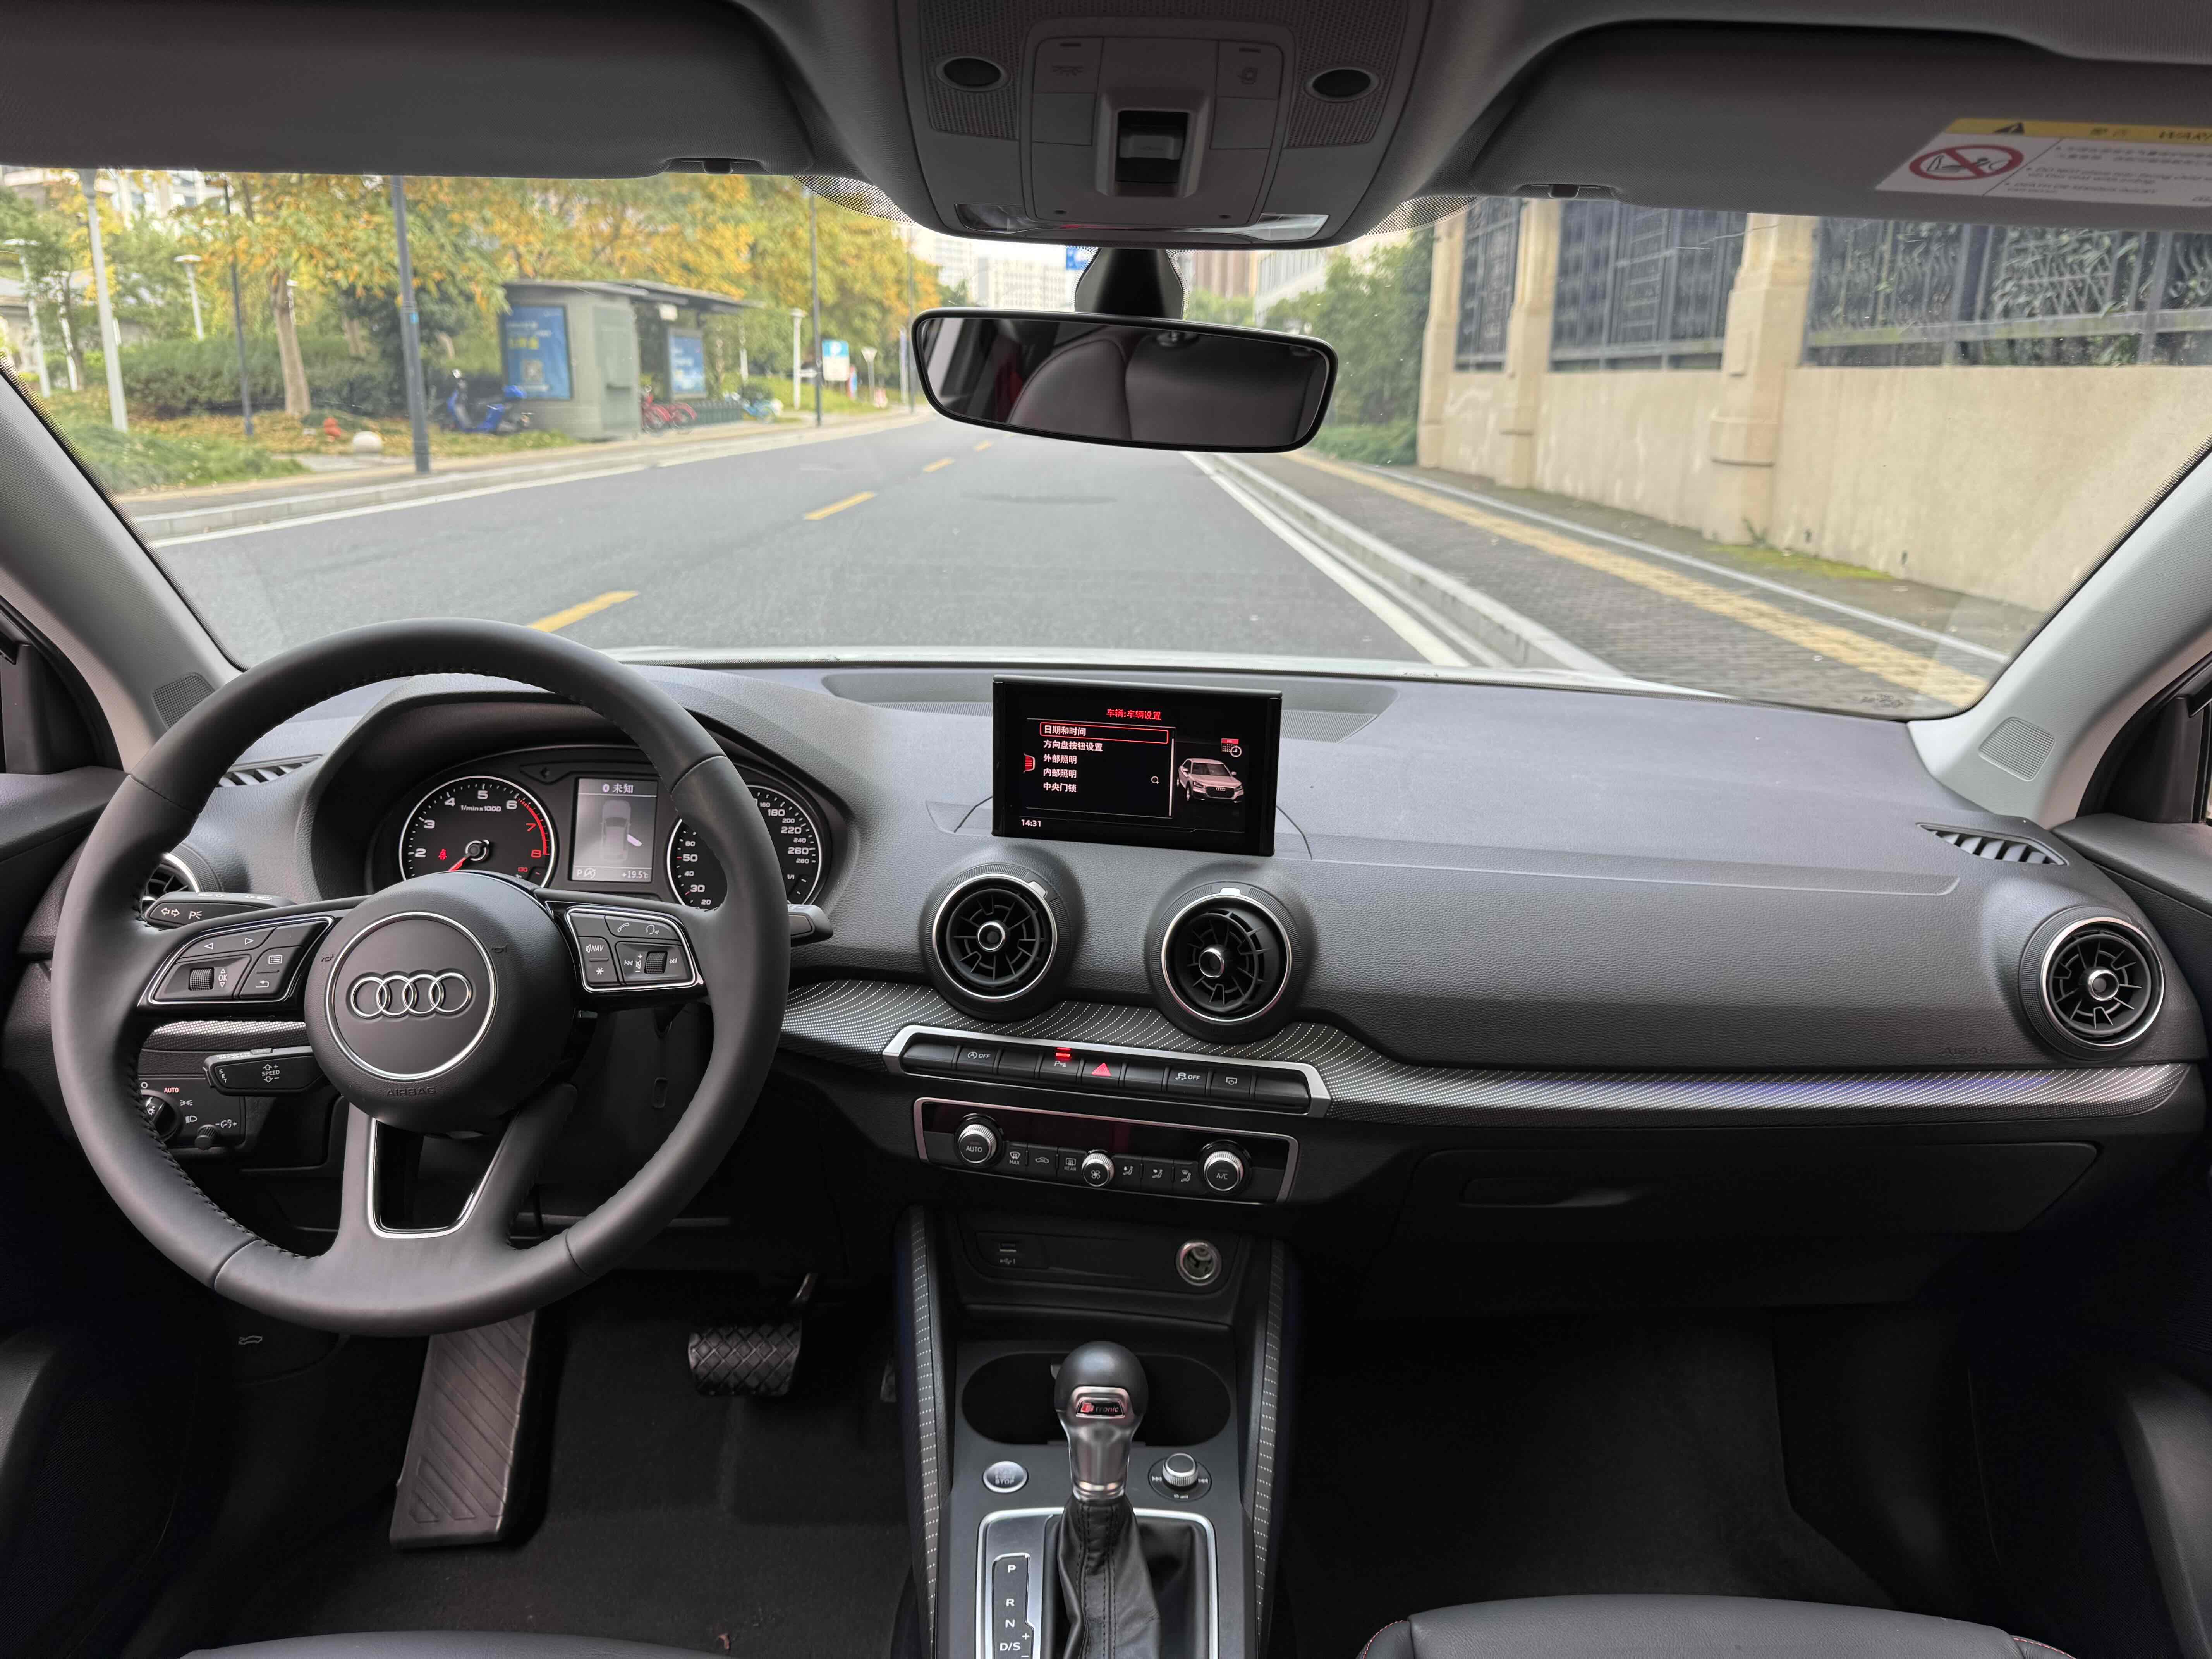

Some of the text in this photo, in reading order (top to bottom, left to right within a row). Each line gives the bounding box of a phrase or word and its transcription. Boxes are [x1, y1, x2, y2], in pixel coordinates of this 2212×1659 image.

[1044, 725, 1086, 736] 日期和时间
[1043, 740, 1103, 752] 方向盘按钮设置
[1043, 754, 1077, 764] 外部照明
[1043, 768, 1077, 778] 内部照明
[613, 783, 633, 793] 未知
[1043, 782, 1077, 792] 中央门锁
[477, 790, 488, 800] 5
[445, 797, 455, 807] 4
[506, 800, 517, 810] 6
[768, 809, 785, 817] 180
[424, 819, 435, 829] 3
[526, 823, 536, 831] 7
[781, 826, 802, 834] 220
[415, 848, 426, 858] 2
[531, 849, 541, 858] 8
[682, 854, 698, 862] 50
[690, 884, 705, 893] 30
[219, 1069, 228, 1083] SET
[387, 1087, 437, 1097] AIRBAG
[1008, 1565, 1016, 1573] P
[1006, 1598, 1015, 1606] R
[1005, 1619, 1015, 1628] N
[1000, 1642, 1021, 1651] D/S
